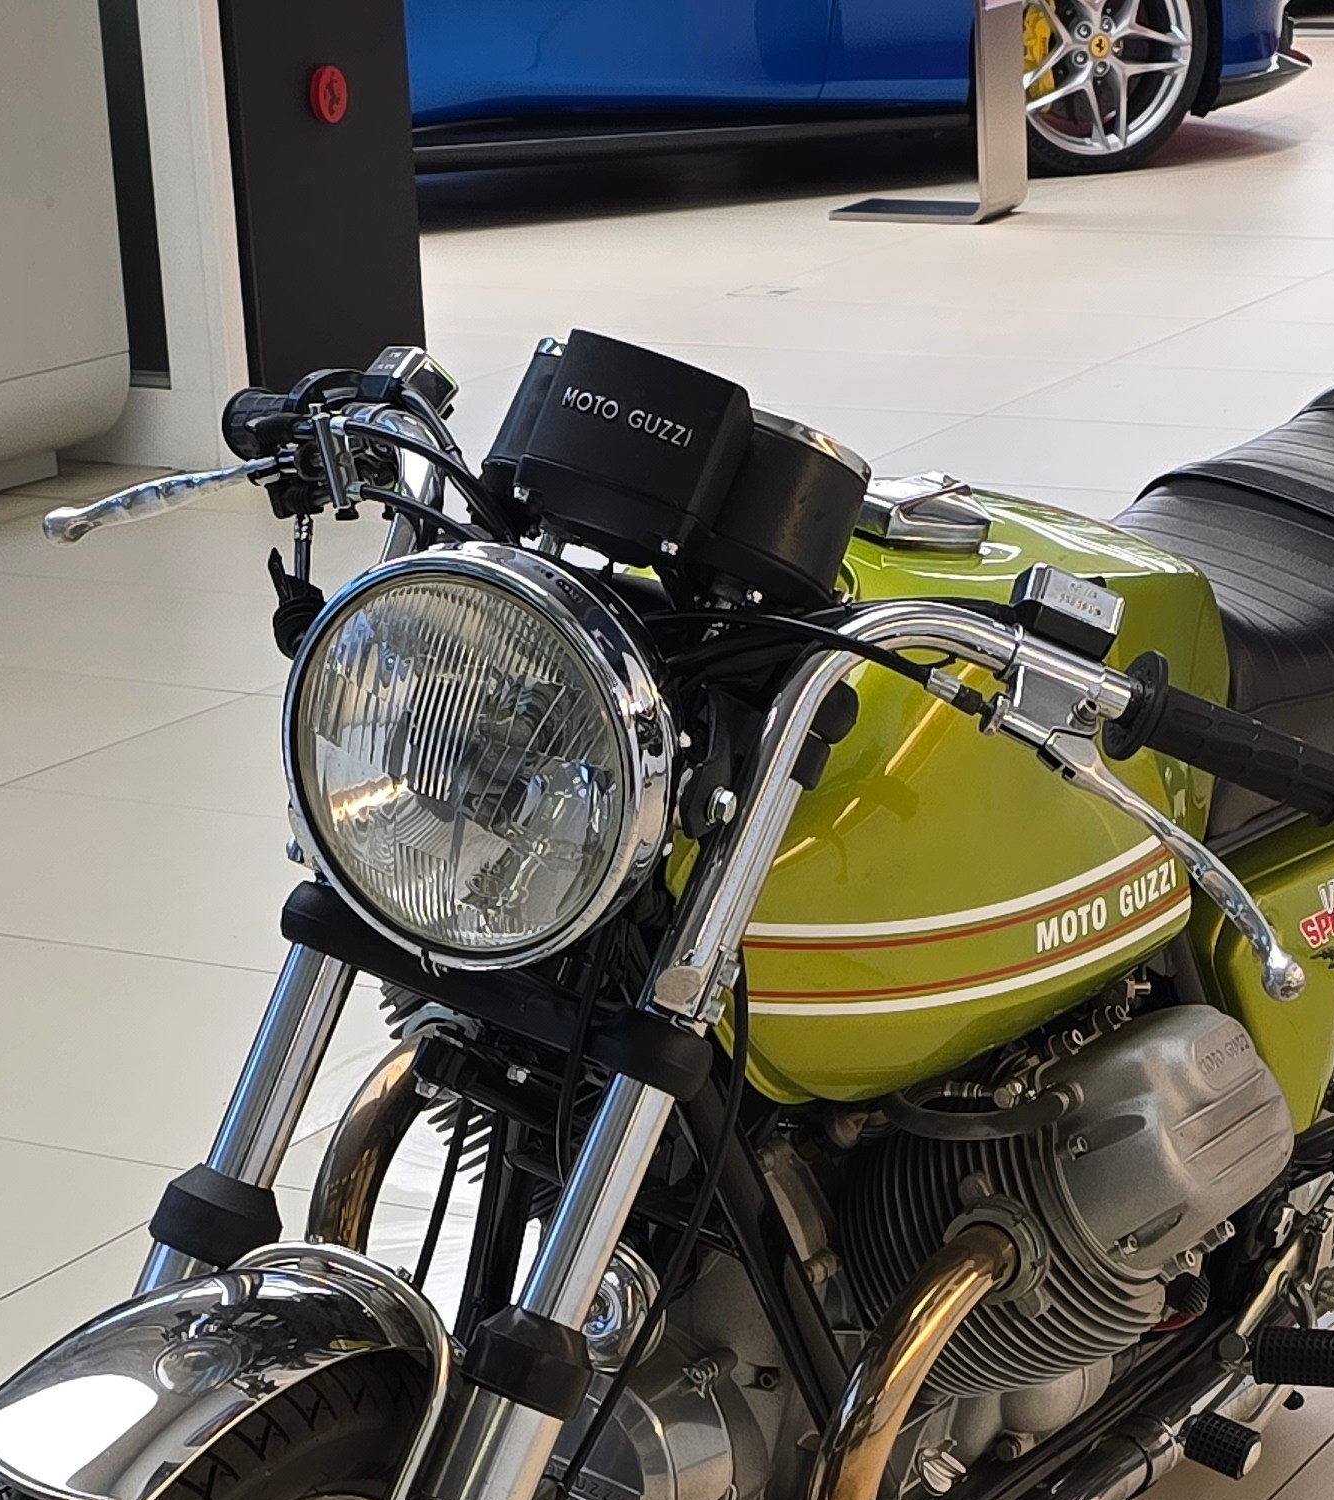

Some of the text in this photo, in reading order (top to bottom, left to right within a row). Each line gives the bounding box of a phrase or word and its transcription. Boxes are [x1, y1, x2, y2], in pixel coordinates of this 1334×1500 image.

[562, 387, 694, 447] MOTO GUZZI
[1036, 858, 1177, 953] MOTO GUZZI
